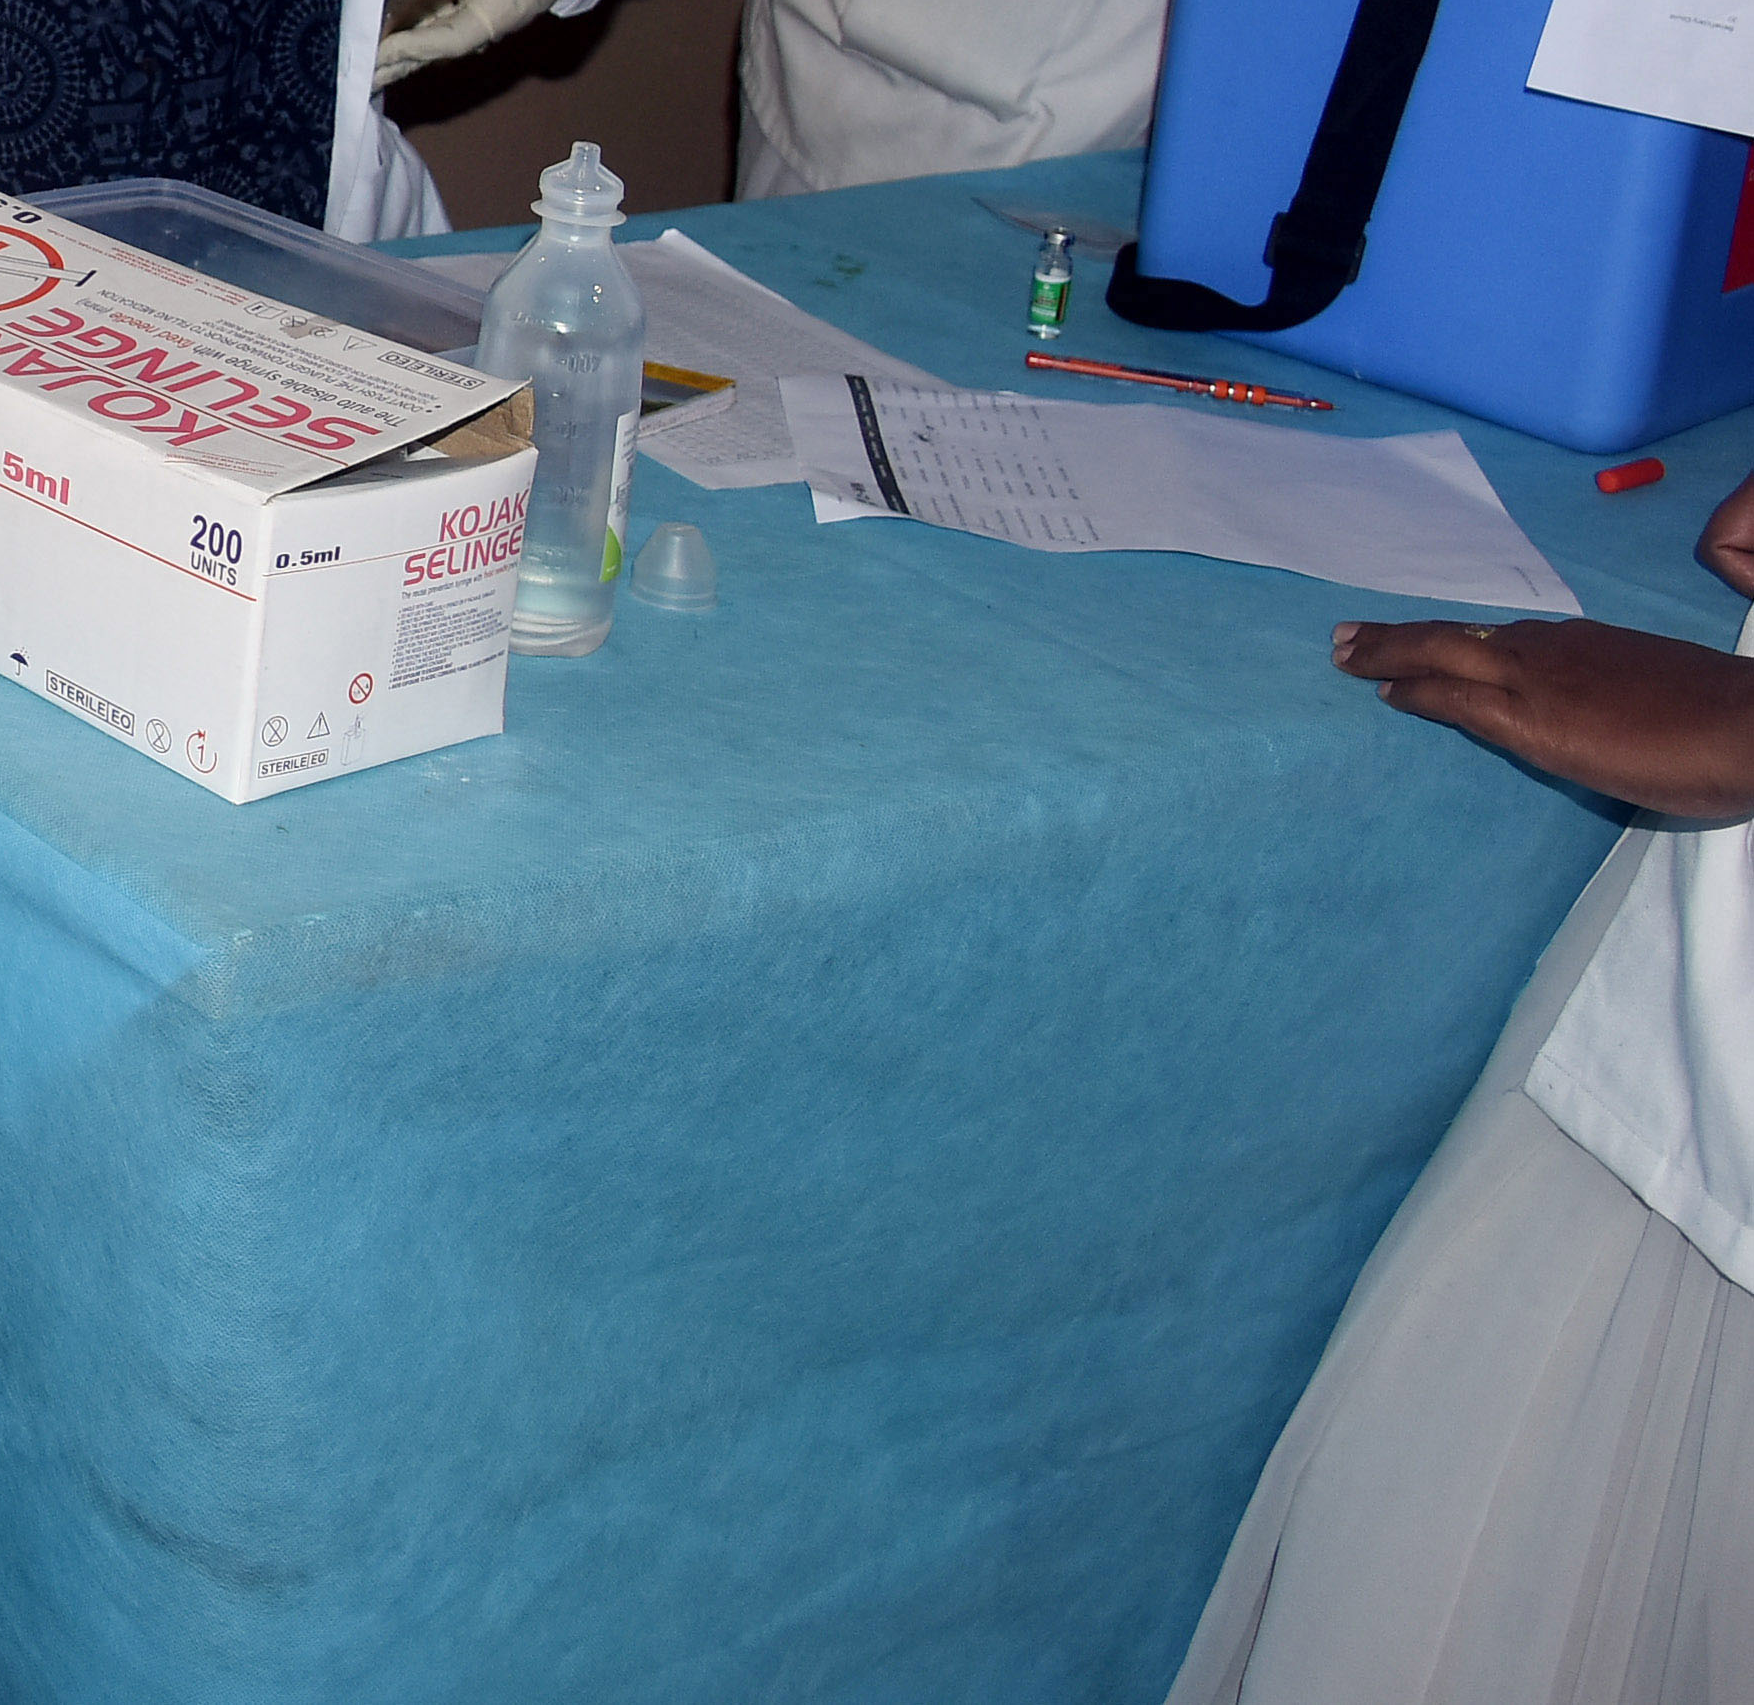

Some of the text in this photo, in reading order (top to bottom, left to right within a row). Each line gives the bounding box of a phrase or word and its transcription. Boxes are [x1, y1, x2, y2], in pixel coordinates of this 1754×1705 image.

[96, 289, 156, 315] MEDICATION
[108, 312, 161, 334] needle
[153, 311, 193, 329] FILLING
[189, 325, 207, 334] TO
[152, 330, 196, 349] fixed
[203, 330, 239, 347] PRIOR
[192, 344, 225, 360] with
[235, 343, 290, 366] FORWARD
[4, 307, 383, 451] SELINGE
[224, 356, 283, 381] syringe
[285, 361, 339, 384] PLUNGER
[379, 354, 478, 388] STERILE EO
[279, 378, 338, 403] disable
[333, 380, 359, 392] THE
[355, 388, 391, 402] PUSH
[336, 399, 376, 415] auto
[373, 411, 407, 427] The
[438, 488, 530, 543] KOJAK
[189, 514, 242, 565] 200
[275, 545, 341, 569] 0.5ml
[403, 524, 523, 586] SELINGE
[190, 550, 237, 587] UNITS
[49, 676, 132, 730] STERILE EO
[259, 748, 327, 779] STERILE EO
